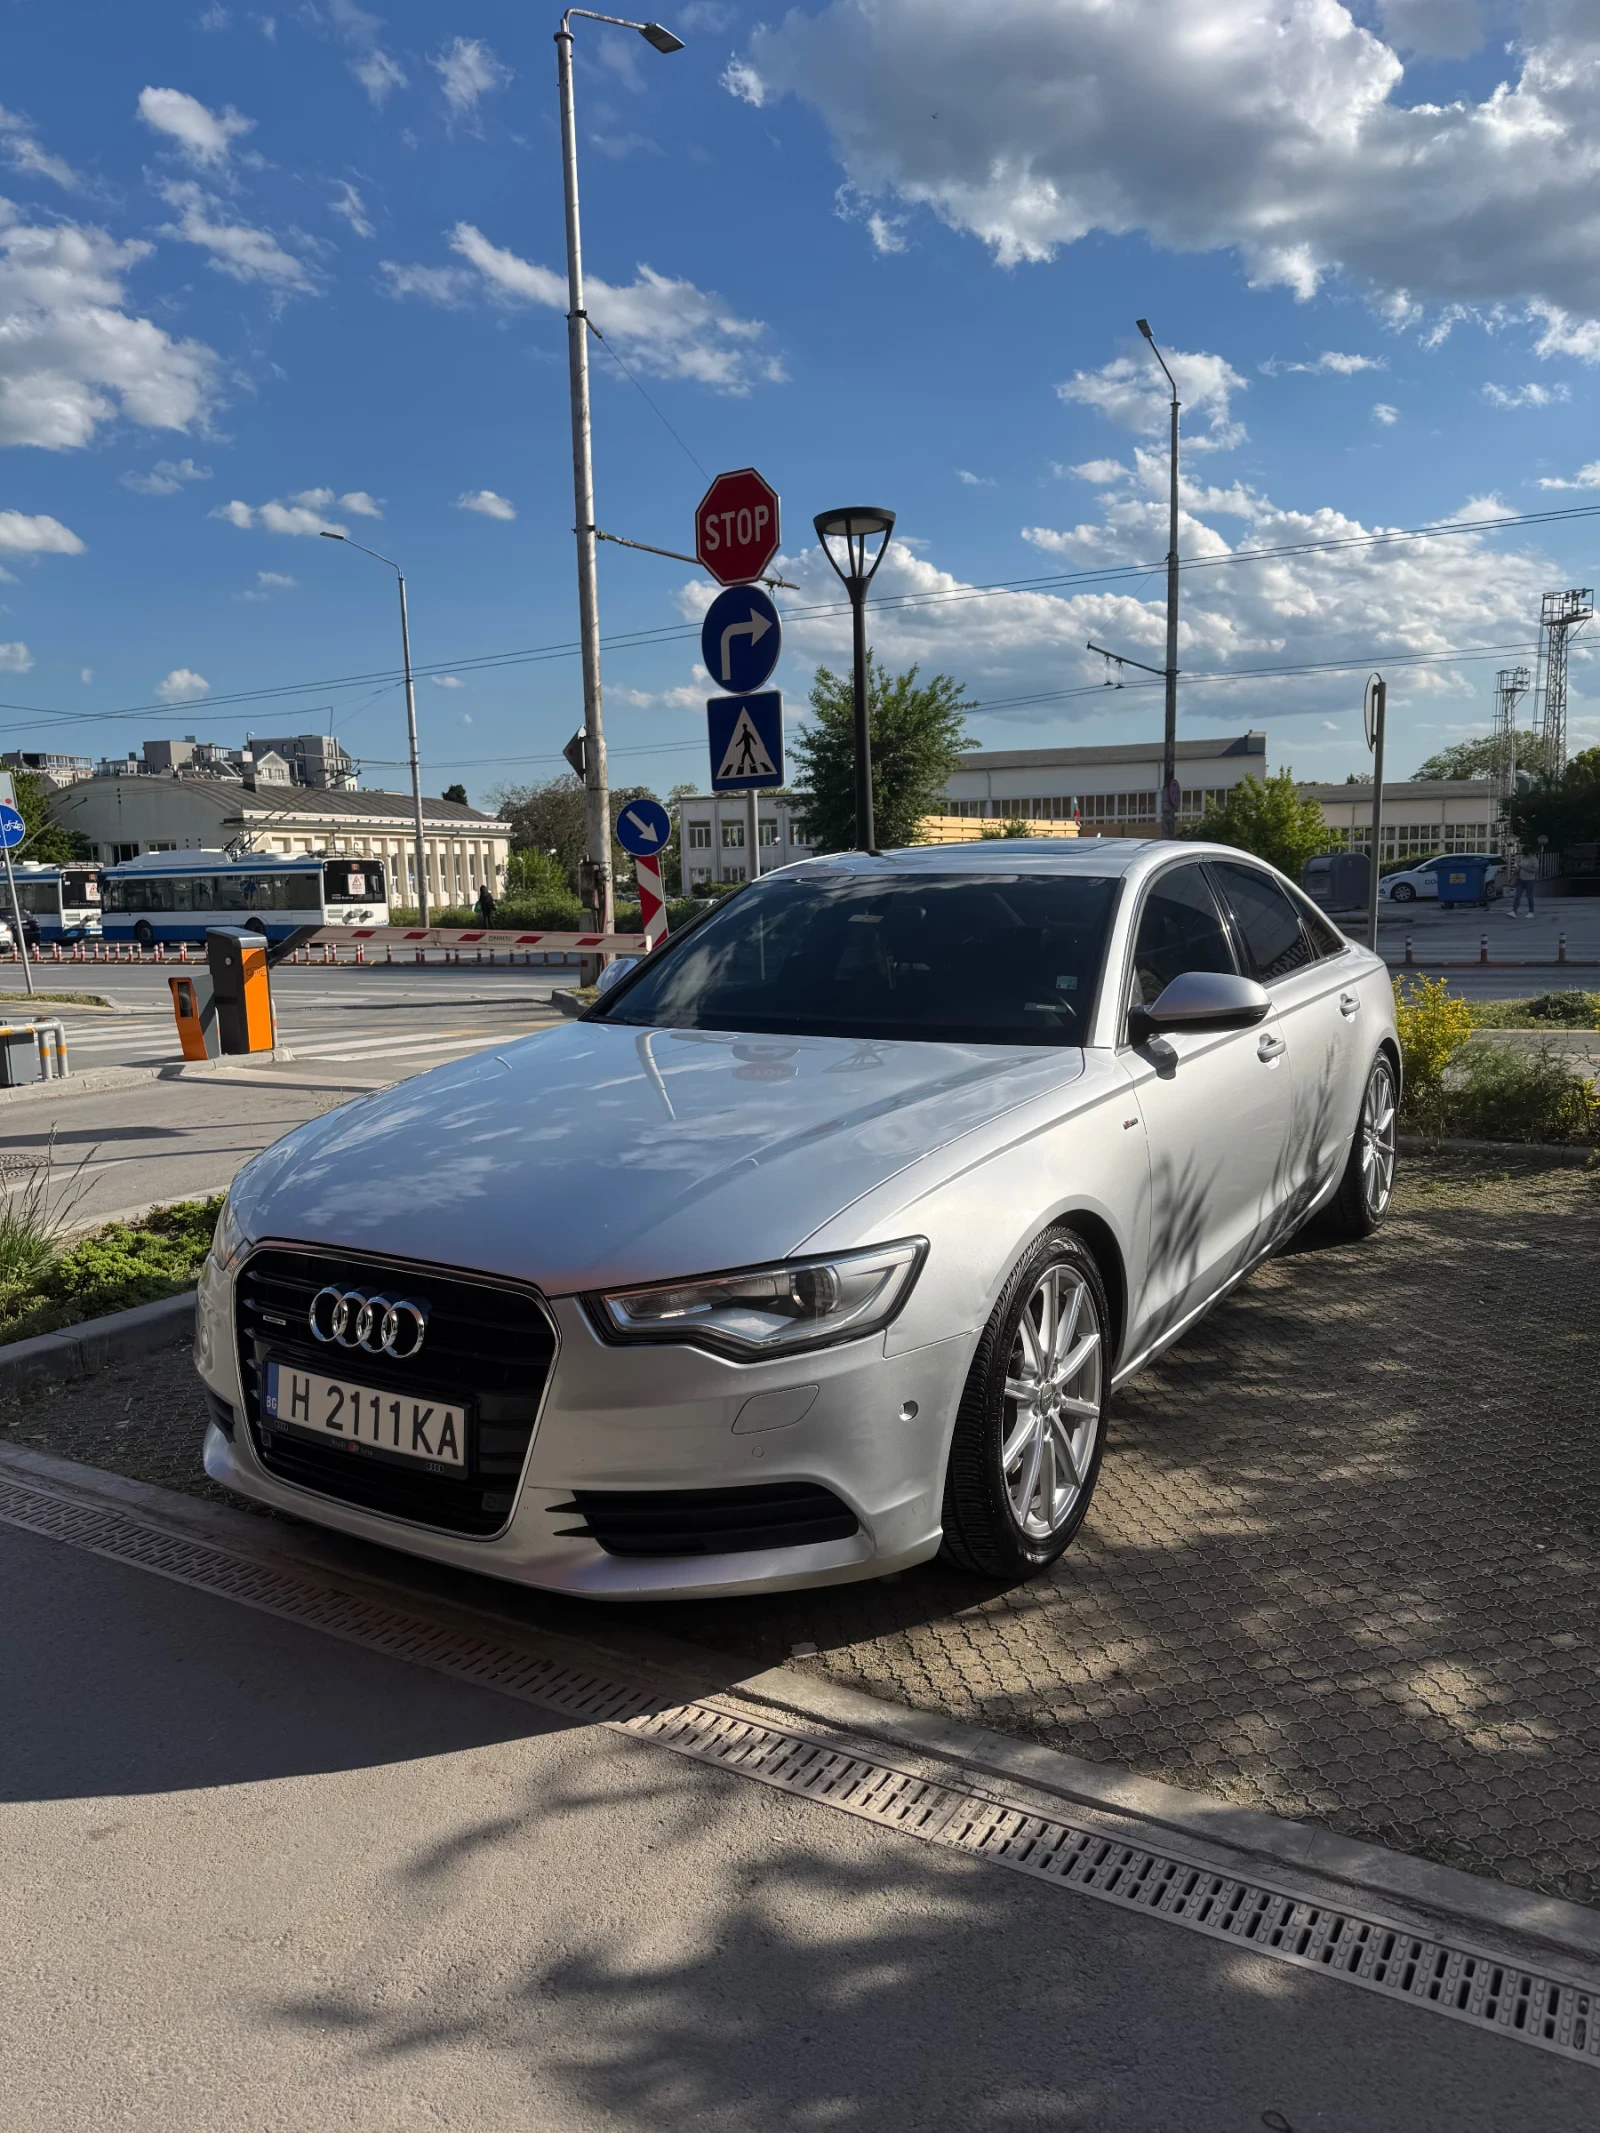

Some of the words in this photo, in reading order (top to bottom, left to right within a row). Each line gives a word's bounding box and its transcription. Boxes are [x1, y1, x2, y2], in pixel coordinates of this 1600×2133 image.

[705, 505, 769, 550] STOP
[266, 1395, 277, 1409] BG
[291, 1375, 310, 1421] H
[326, 1385, 458, 1459] 2111KA
